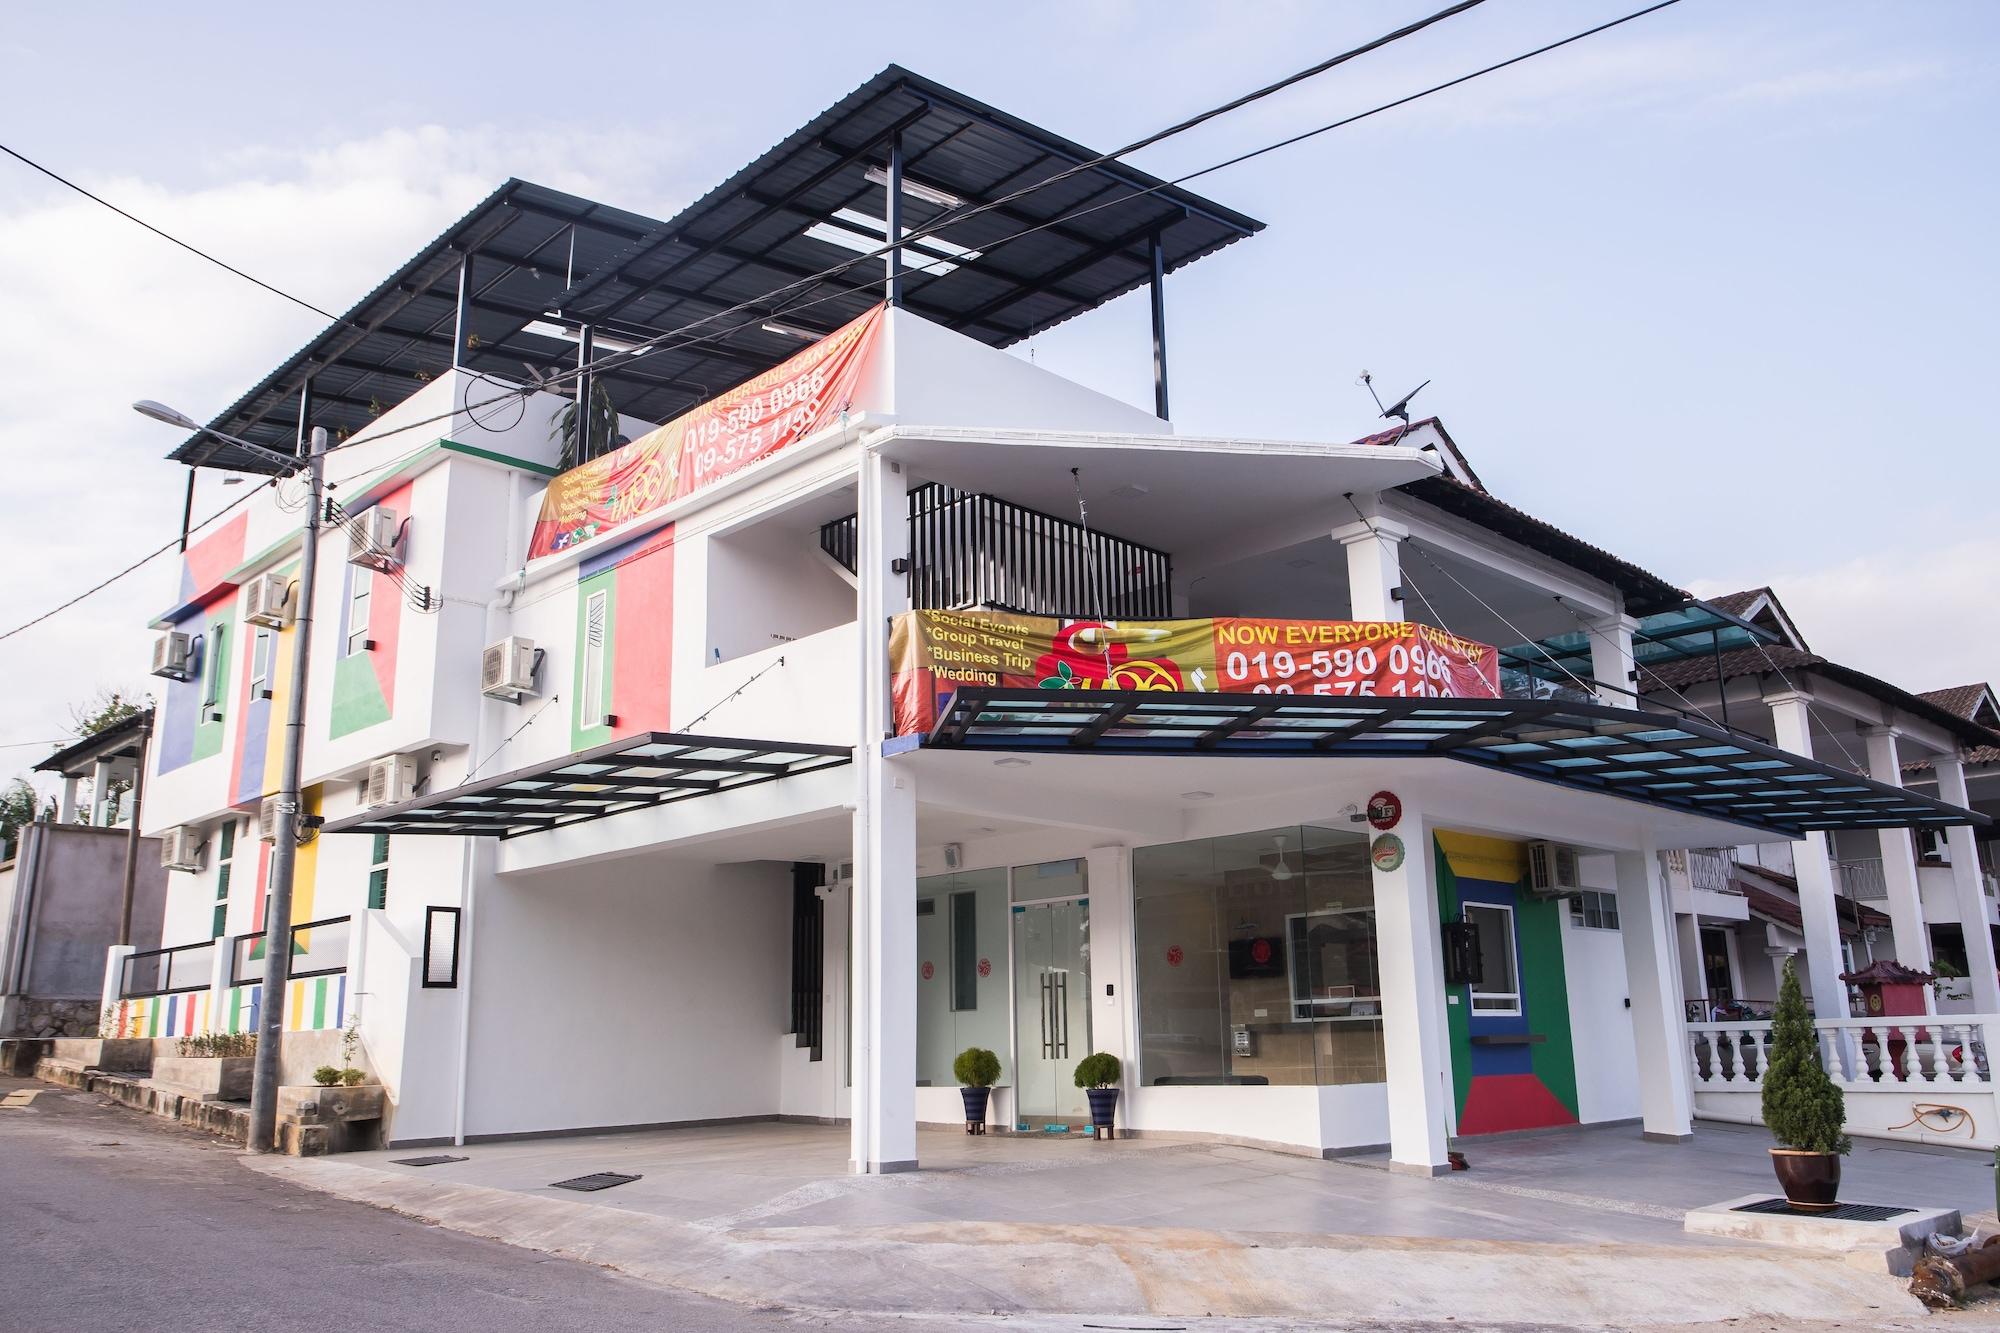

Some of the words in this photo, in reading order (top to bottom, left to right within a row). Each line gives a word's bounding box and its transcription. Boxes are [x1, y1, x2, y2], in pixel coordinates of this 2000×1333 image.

[792, 347, 825, 373] CAN
[686, 397, 764, 453] 019-590
[770, 367, 825, 412] 0966
[694, 429, 763, 478] 09-575
[979, 618, 1029, 636] Events
[980, 634, 1025, 650] Travel
[1218, 625, 1279, 645] NOW
[1286, 622, 1415, 644] EVERYONE
[1419, 623, 1448, 649] CAN
[1451, 637, 1484, 663] STAY
[1003, 652, 1032, 670] Trip
[1226, 646, 1377, 680] 019-590
[1389, 644, 1452, 684] 0966
